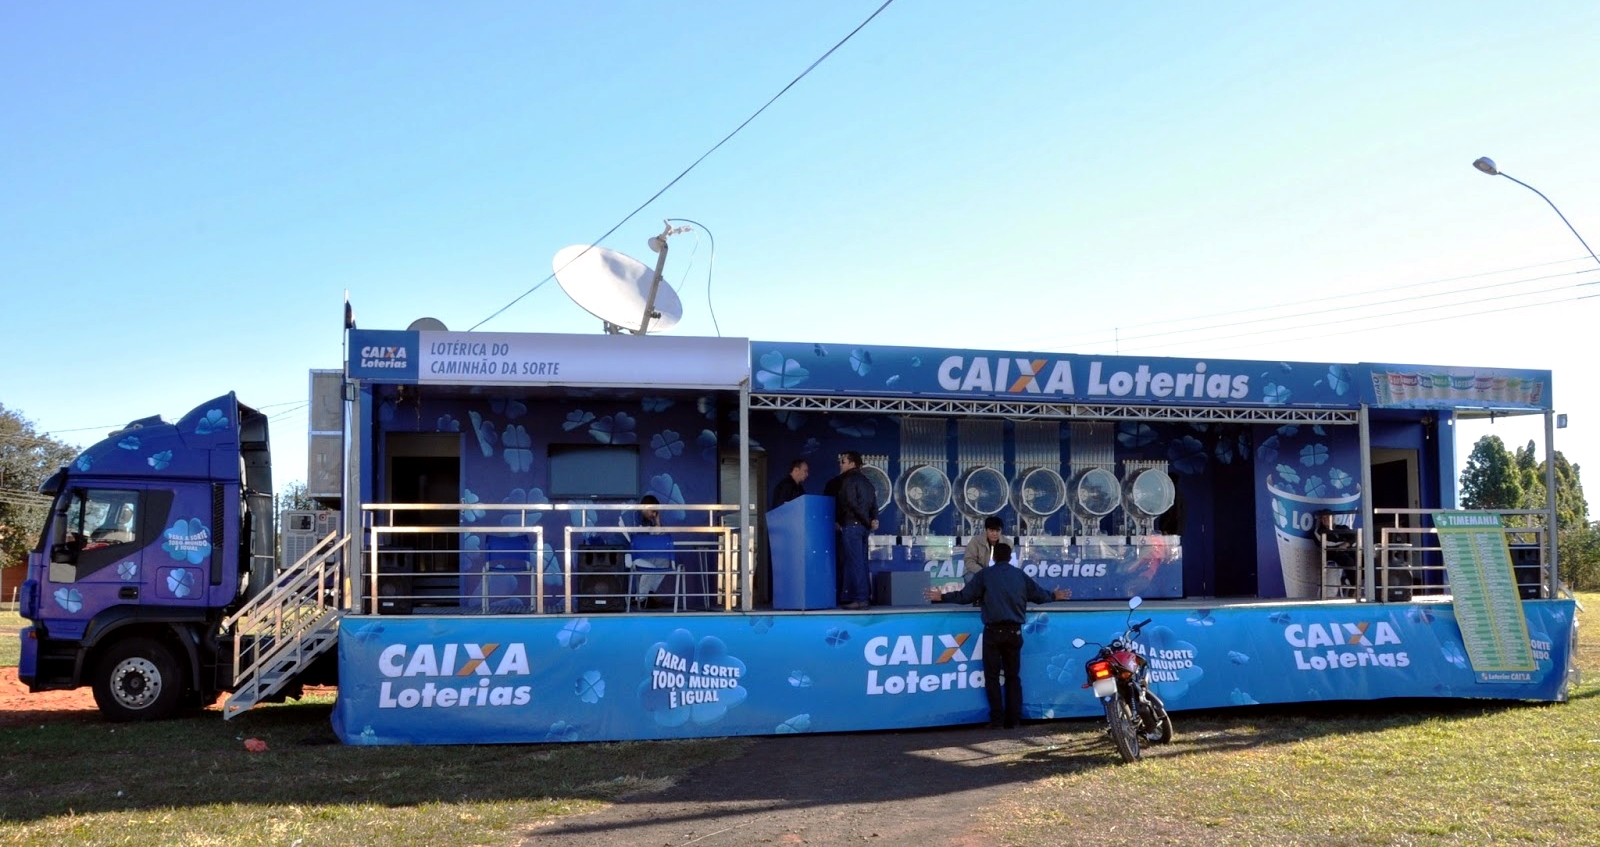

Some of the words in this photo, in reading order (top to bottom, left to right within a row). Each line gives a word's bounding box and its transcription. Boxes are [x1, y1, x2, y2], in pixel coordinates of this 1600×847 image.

[361, 346, 407, 358] CAIXA
[430, 340, 487, 356] LOTÉRICA
[491, 343, 509, 356] DO
[361, 358, 407, 369] Loterias
[430, 359, 497, 375] CAMINHÃO
[501, 362, 518, 375] DA
[522, 362, 560, 375] SORTE
[937, 355, 1075, 395] CAIXA
[1087, 361, 1249, 399] Loterias
[1448, 515, 1499, 526] TIMEMANIA
[1086, 537, 1090, 545] 5
[1141, 537, 1146, 545] 6
[1022, 558, 1107, 578] oterias
[1284, 621, 1402, 648] CAIXA
[1149, 646, 1157, 658] A
[1159, 649, 1194, 660] SORTE
[1531, 640, 1551, 651] ORTE
[378, 643, 531, 678] CAIXA
[655, 647, 687, 672] PARA
[689, 661, 699, 674] A
[702, 664, 740, 678] SORTE
[1293, 647, 1410, 671] Loterias
[1533, 650, 1550, 660] NDO
[1150, 659, 1193, 669] MUNDO
[652, 670, 685, 690] TODO
[688, 675, 738, 689] MUNDO
[866, 663, 1005, 695] Loteria
[1510, 673, 1531, 681] CAIXA
[378, 678, 533, 709] Loterias
[669, 687, 678, 709] É
[681, 690, 719, 706] IGUAL
